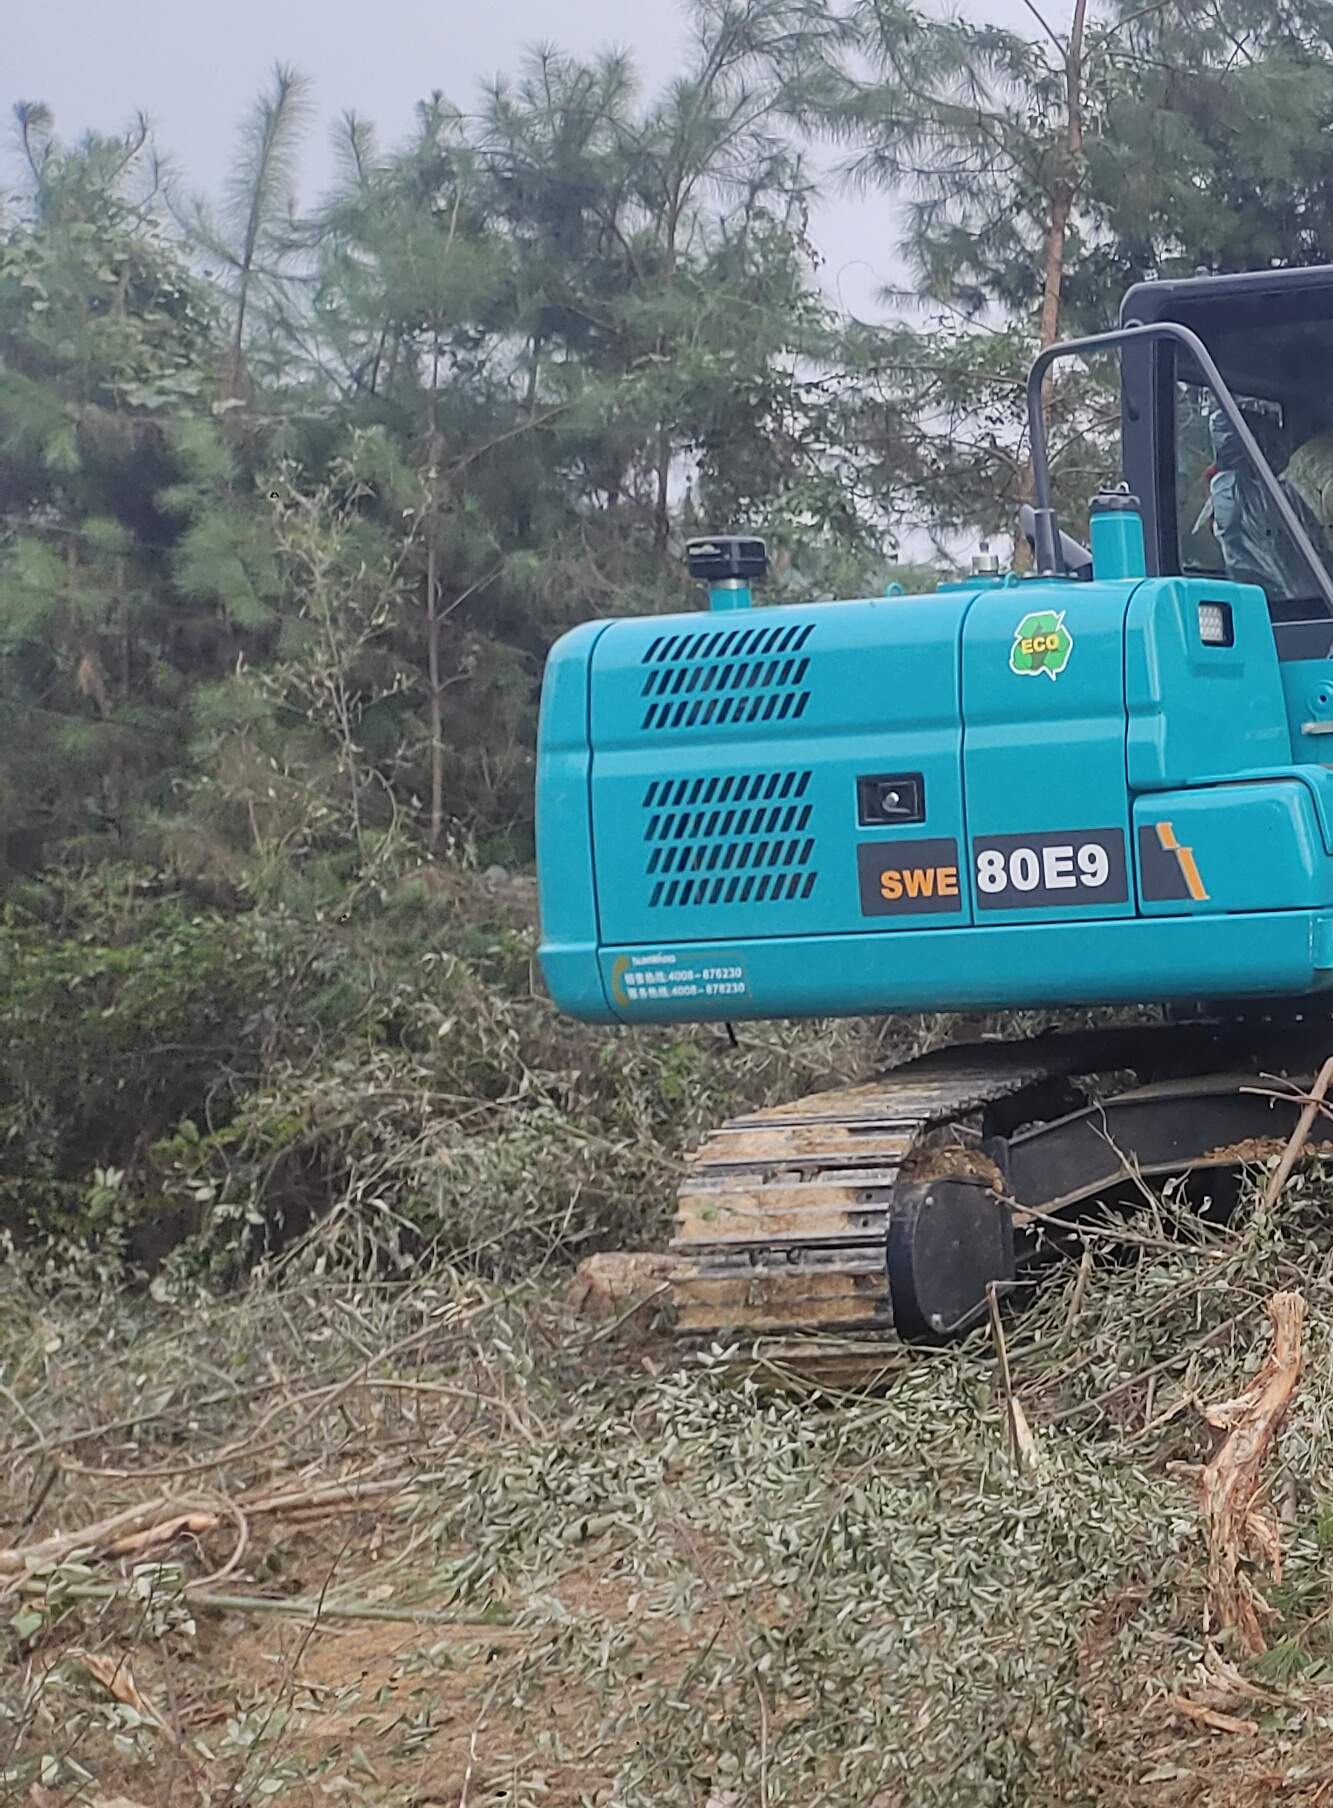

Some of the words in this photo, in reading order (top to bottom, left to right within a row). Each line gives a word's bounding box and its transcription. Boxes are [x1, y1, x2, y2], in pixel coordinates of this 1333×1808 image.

[1021, 633, 1060, 655] ECO
[880, 866, 959, 900] SWE
[976, 843, 1110, 894] 80E9
